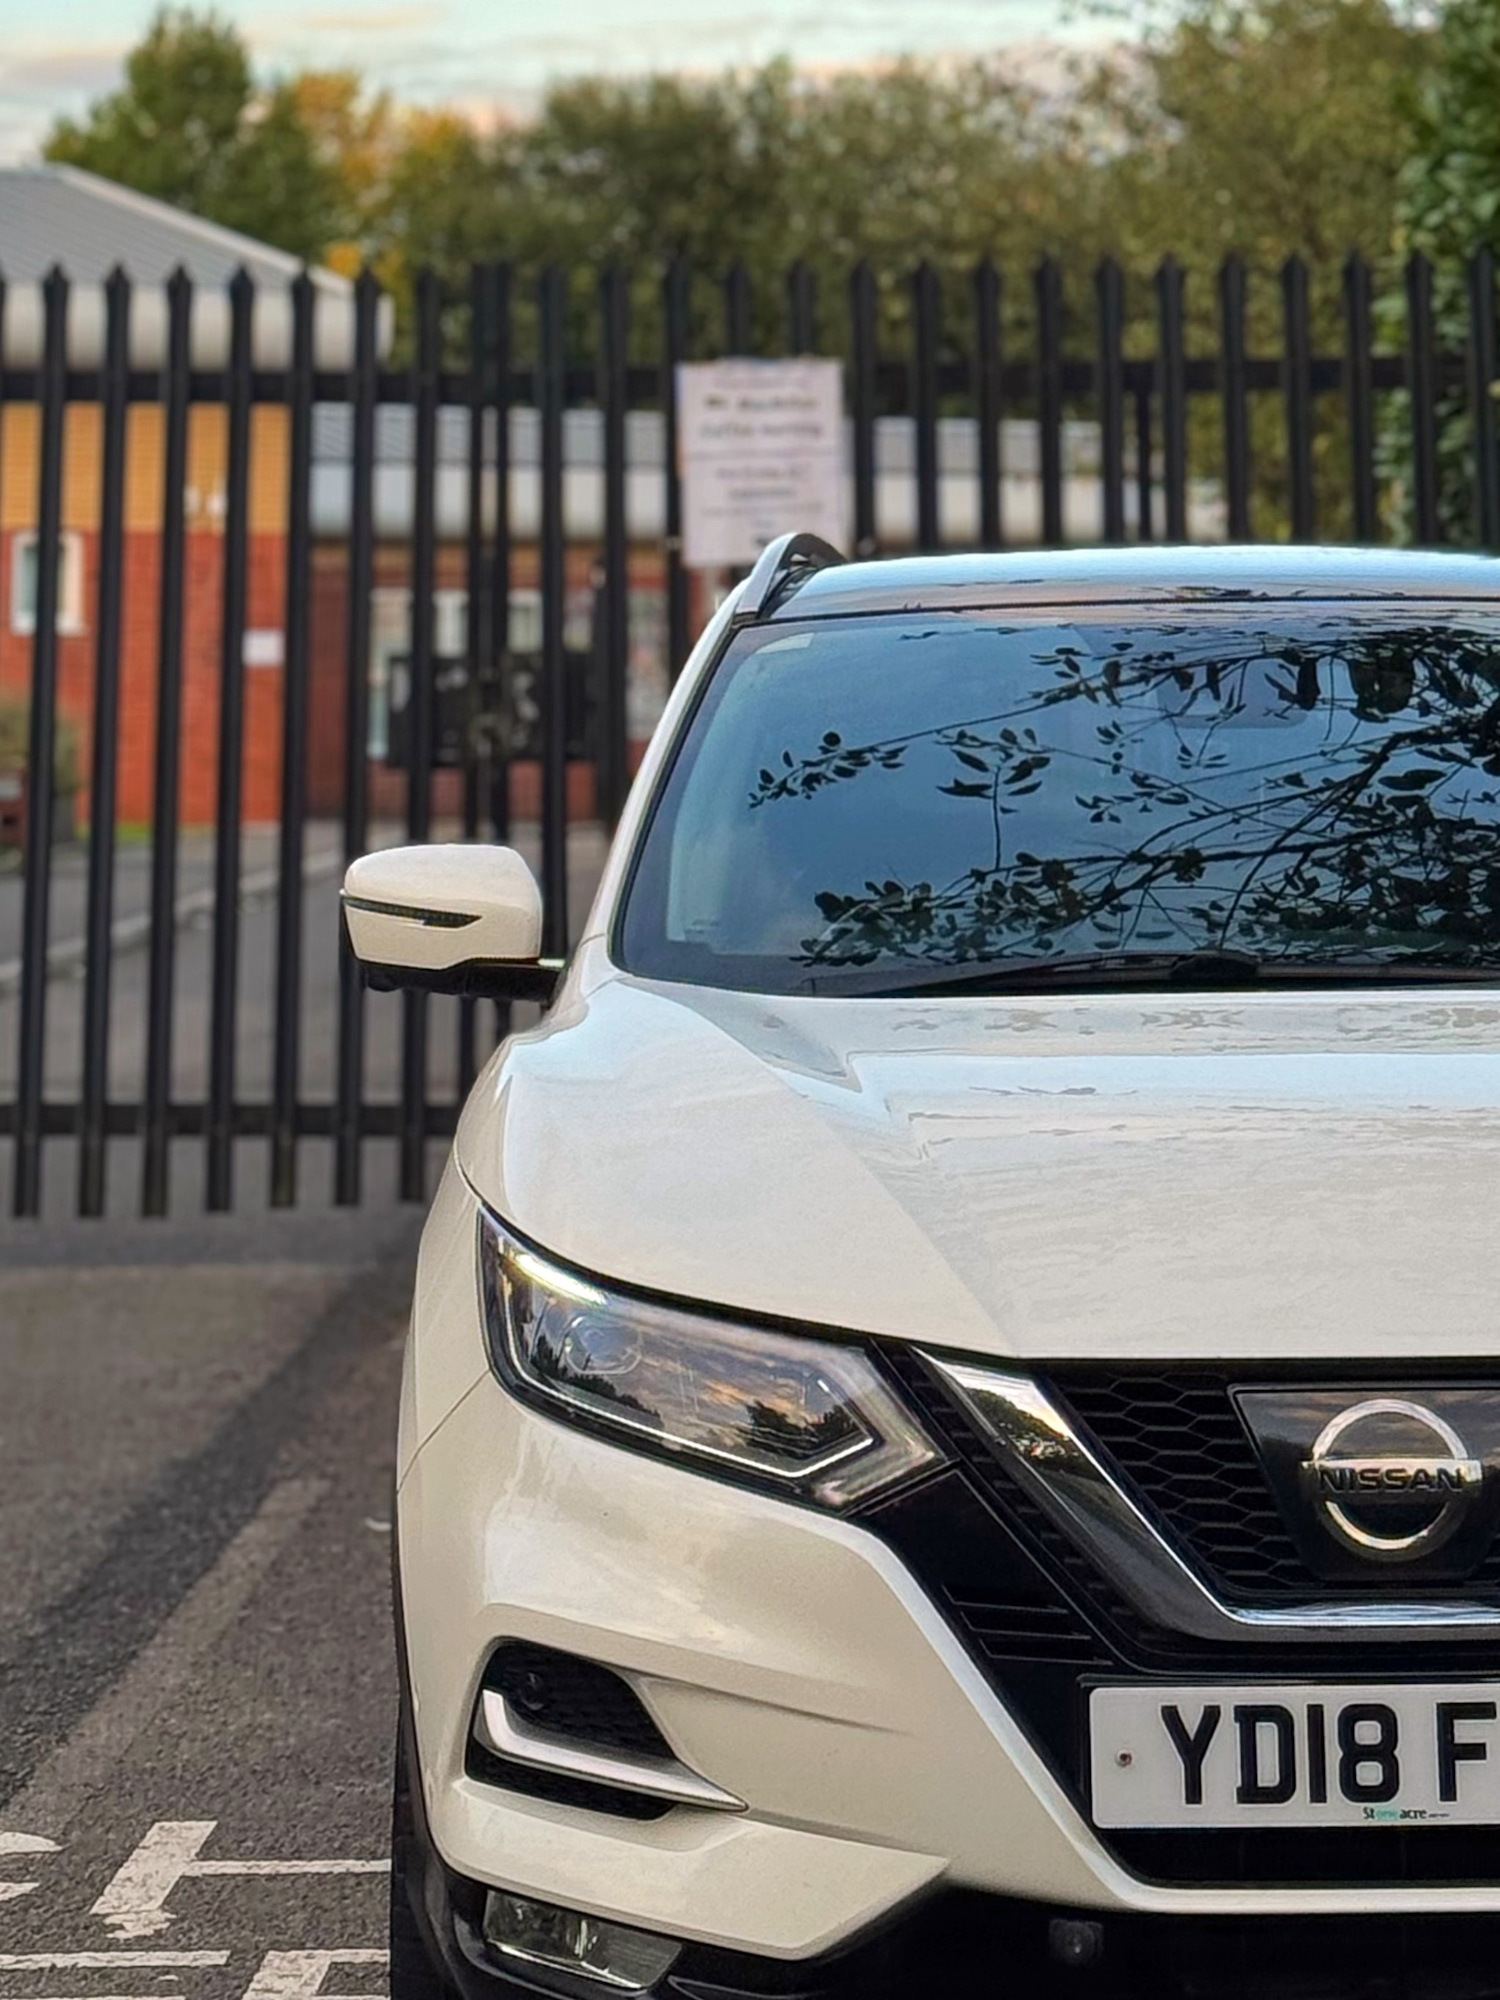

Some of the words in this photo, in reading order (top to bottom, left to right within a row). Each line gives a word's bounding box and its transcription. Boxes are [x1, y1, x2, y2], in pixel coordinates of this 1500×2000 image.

[1319, 1467, 1463, 1493] NISSAN
[1160, 1703, 1401, 1805] YD18
[1436, 1702, 1498, 1802] F
